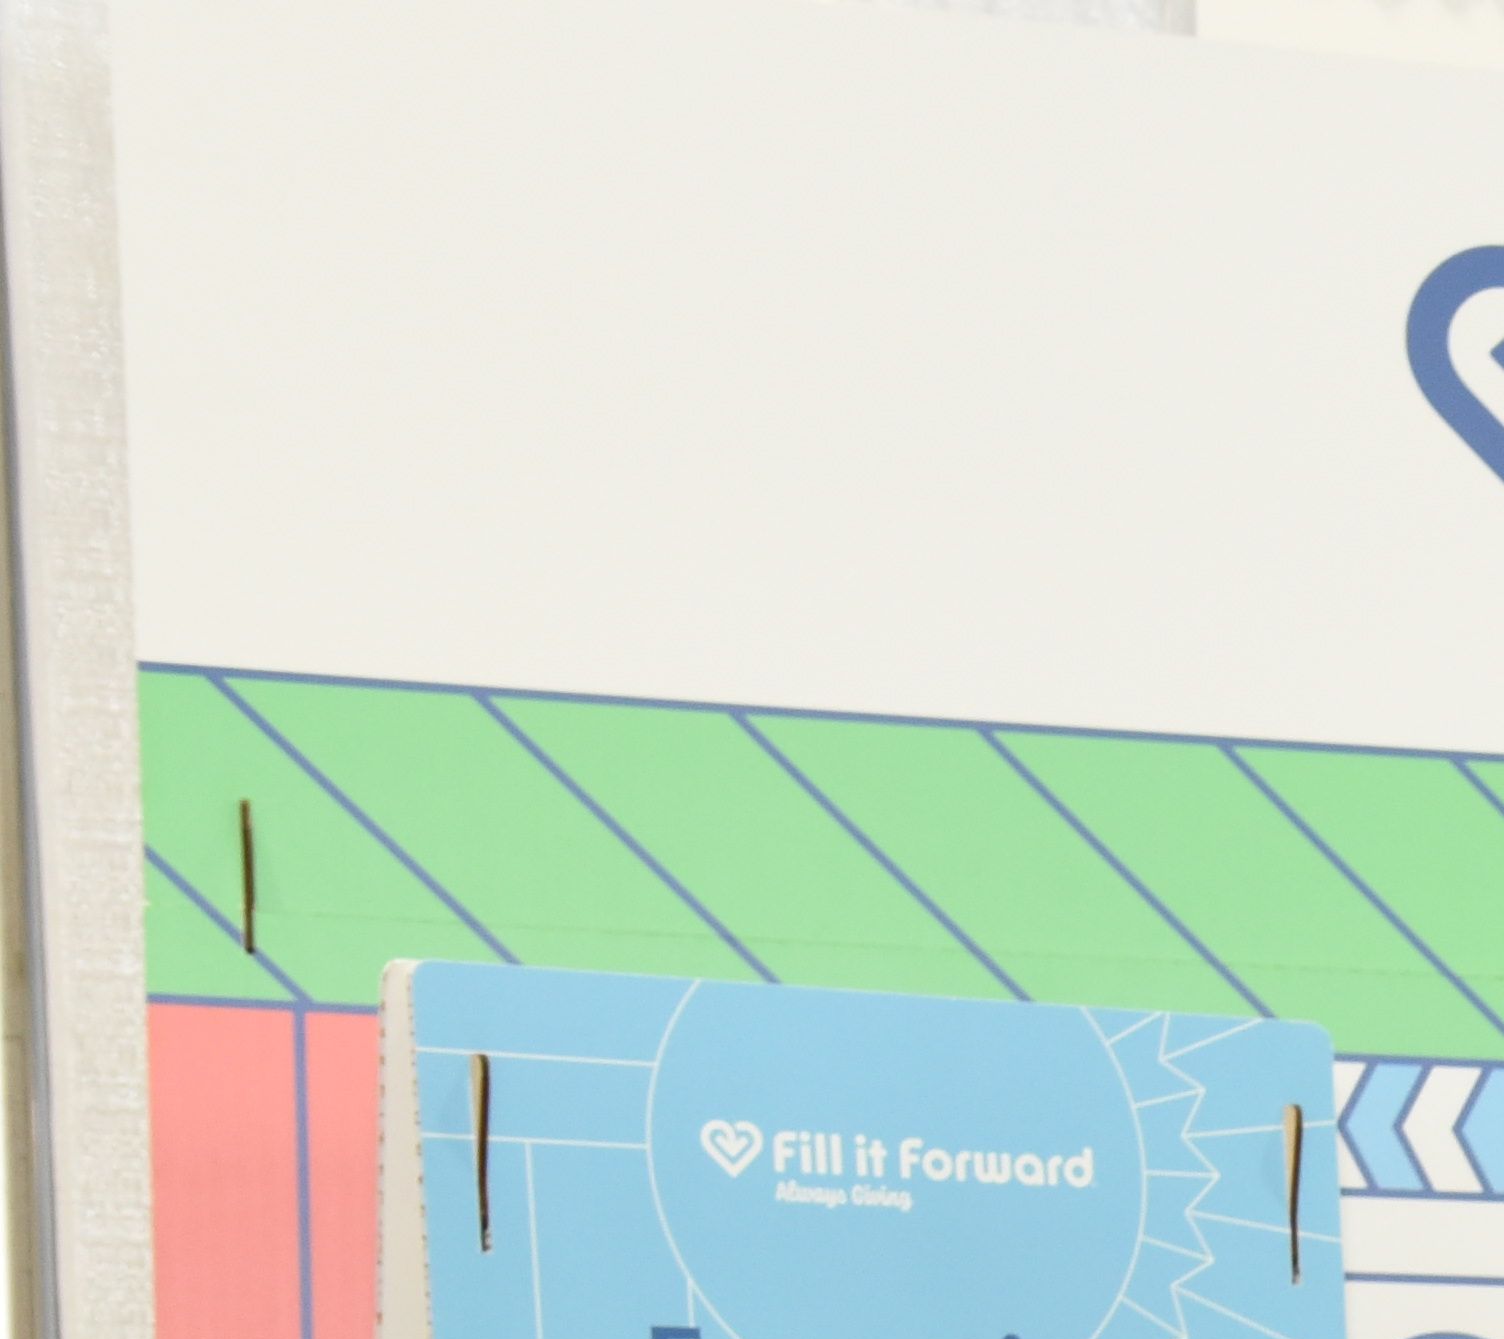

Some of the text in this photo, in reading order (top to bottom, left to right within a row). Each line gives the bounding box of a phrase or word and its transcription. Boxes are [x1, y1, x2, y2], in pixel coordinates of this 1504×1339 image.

[773, 1131, 1094, 1188] Fill it Forward
[775, 1180, 913, 1213] Always Giving
